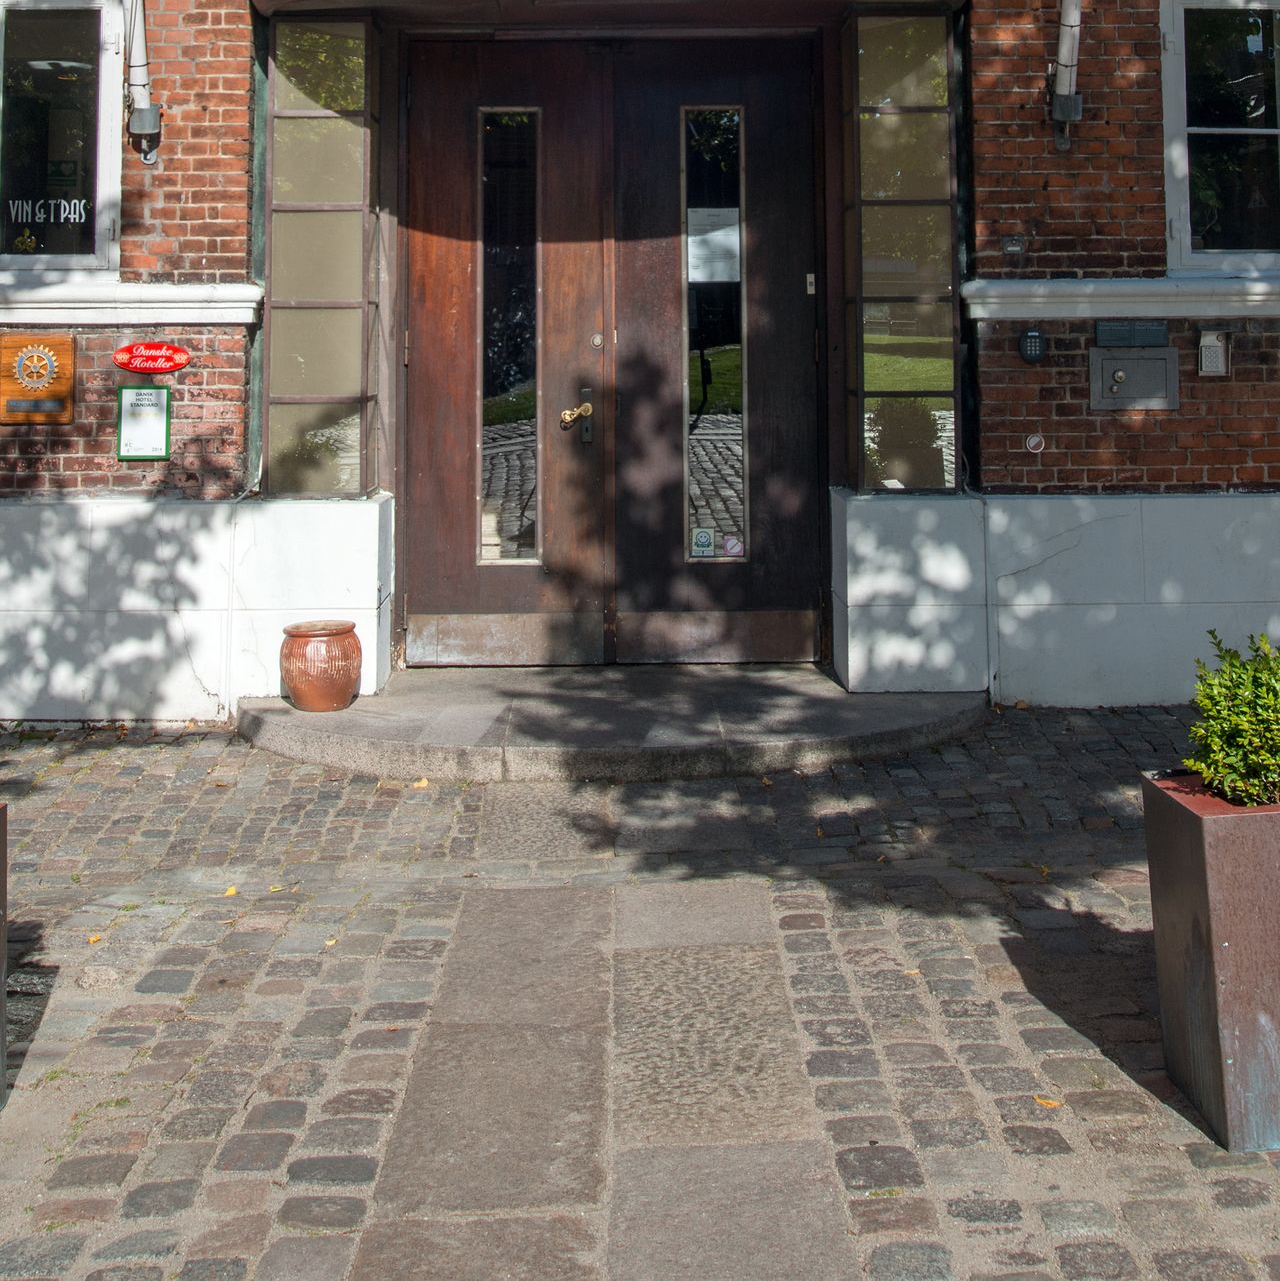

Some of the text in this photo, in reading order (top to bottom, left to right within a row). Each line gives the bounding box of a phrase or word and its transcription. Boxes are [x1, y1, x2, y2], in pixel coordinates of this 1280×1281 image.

[8, 199, 32, 223] VIN
[35, 199, 46, 223] &
[132, 344, 174, 356] Danske
[129, 356, 174, 368] Hoteller
